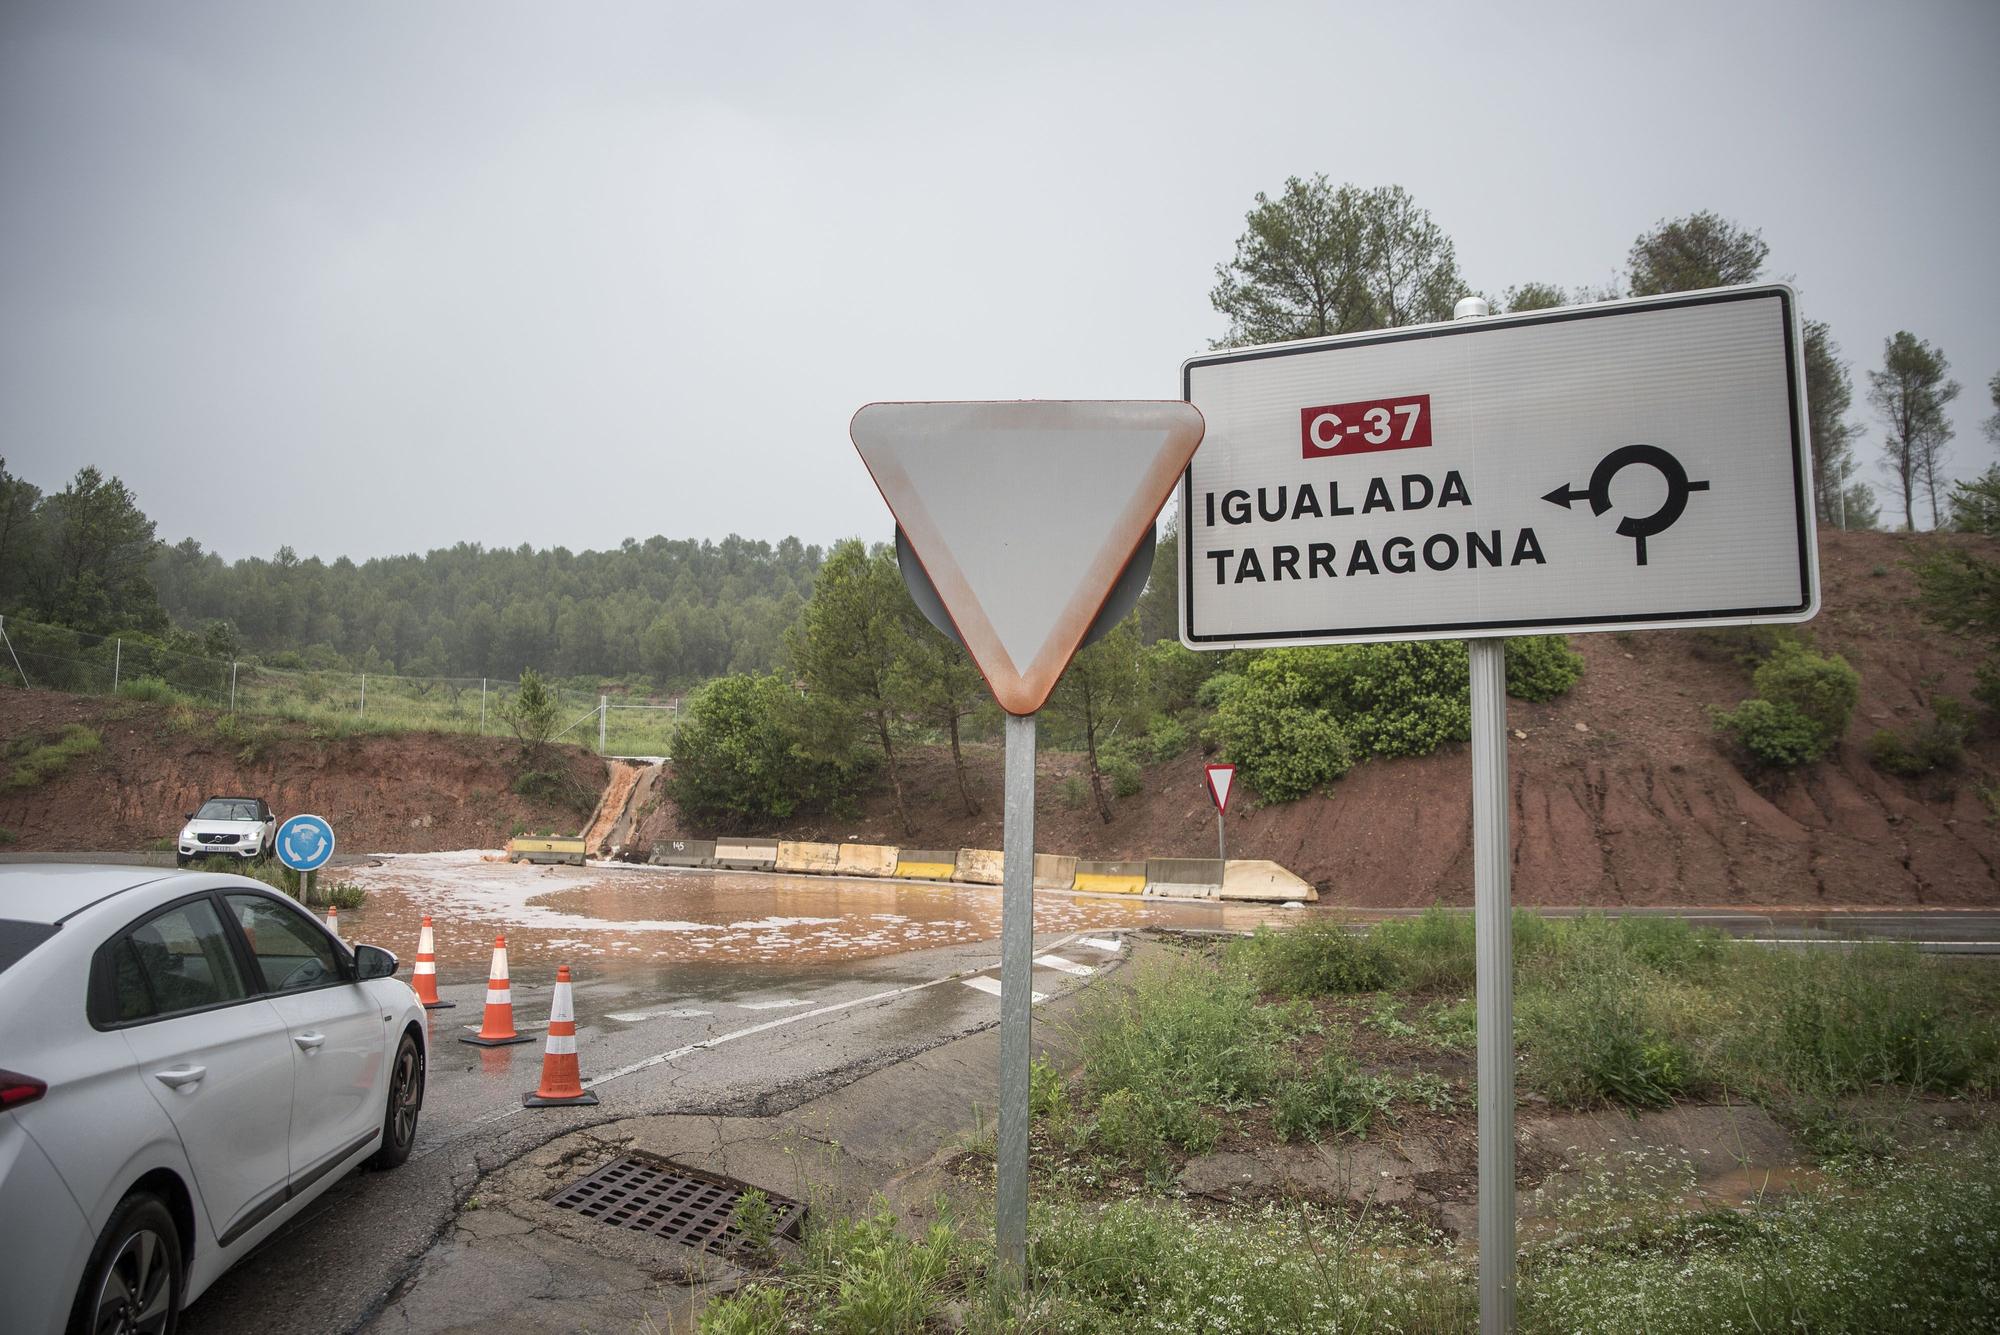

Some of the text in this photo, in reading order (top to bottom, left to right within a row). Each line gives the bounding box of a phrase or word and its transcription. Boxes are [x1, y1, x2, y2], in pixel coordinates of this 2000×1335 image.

[1309, 403, 1422, 450] C-37
[1206, 470, 1473, 527] IGUALADA
[1207, 527, 1547, 585] TARRAGONA
